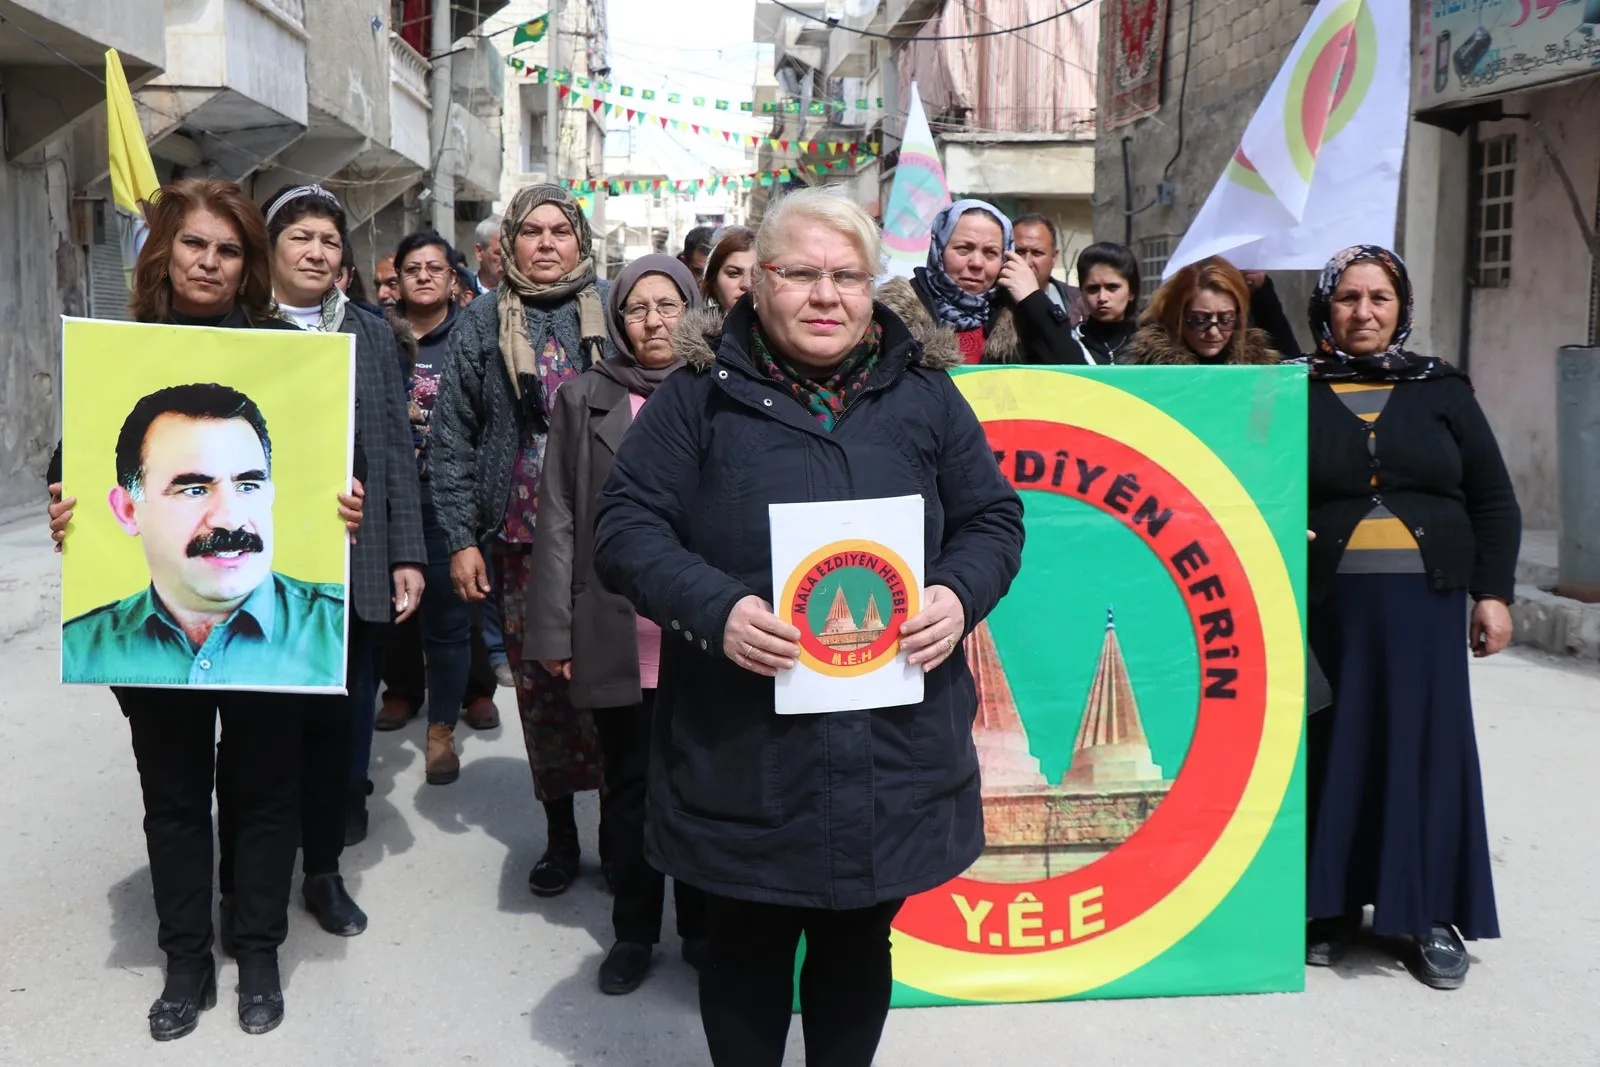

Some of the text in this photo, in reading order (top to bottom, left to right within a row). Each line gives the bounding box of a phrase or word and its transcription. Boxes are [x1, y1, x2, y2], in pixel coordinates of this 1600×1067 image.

[794, 577, 819, 614] MALA
[1171, 540, 1240, 699] EFRÎN
[831, 650, 872, 666] M.Ê.H
[951, 885, 1105, 948] Y.Ê.E
